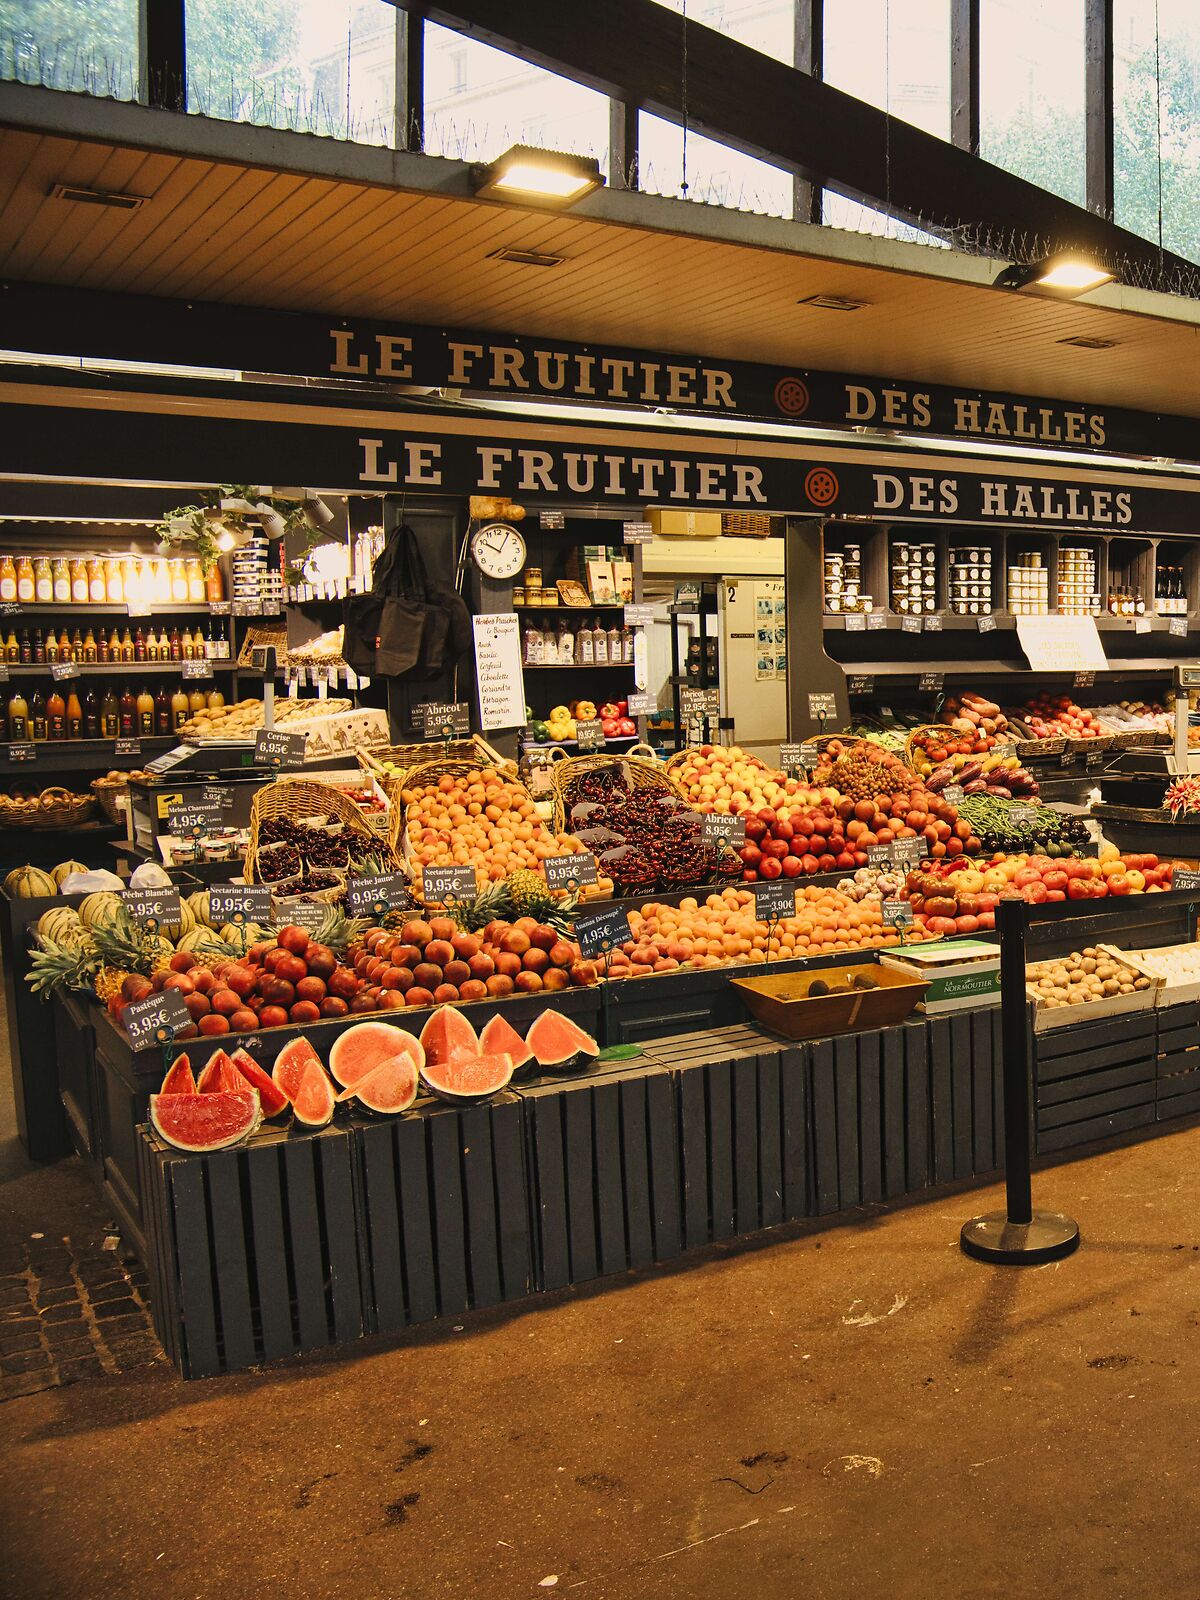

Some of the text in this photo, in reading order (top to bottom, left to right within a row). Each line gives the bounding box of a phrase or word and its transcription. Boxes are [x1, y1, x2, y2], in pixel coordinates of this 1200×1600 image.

[330, 330, 1106, 446] LE FRUITIER DES HALLES
[358, 438, 1132, 524] LE FRUITIER DES HALLES
[728, 586, 735, 602] 2
[682, 690, 704, 698] Abricot
[426, 704, 461, 715] Abricot
[683, 702, 708, 712] 12,95€
[427, 714, 454, 727] 5,95€
[267, 731, 291, 742] Cerise
[259, 741, 289, 755] 6,95€
[782, 754, 806, 764] 5,95€
[168, 803, 219, 813] Melon Charentais
[169, 814, 207, 828] 4,95€
[704, 813, 739, 825] Abricot
[705, 825, 732, 837] 8,95€
[545, 854, 588, 867] Pêche Plate
[548, 865, 582, 880] 9,95€
[352, 875, 395, 889] Pêche Jaune
[424, 878, 462, 893] 9,95€
[1175, 879, 1198, 889] 7,95€
[122, 889, 174, 899] Pêche Blanche
[210, 887, 270, 895] Nectarine Blanche
[352, 887, 389, 905] 9,95€
[211, 897, 255, 913] 9,95€
[771, 900, 794, 911] 3,90€
[575, 908, 619, 931] Ananas Découpé
[582, 924, 613, 944] 4,95€
[944, 979, 993, 993] NOIRMOUTIER
[130, 995, 166, 1016] Pastèque
[129, 1008, 171, 1037] 3,95€
